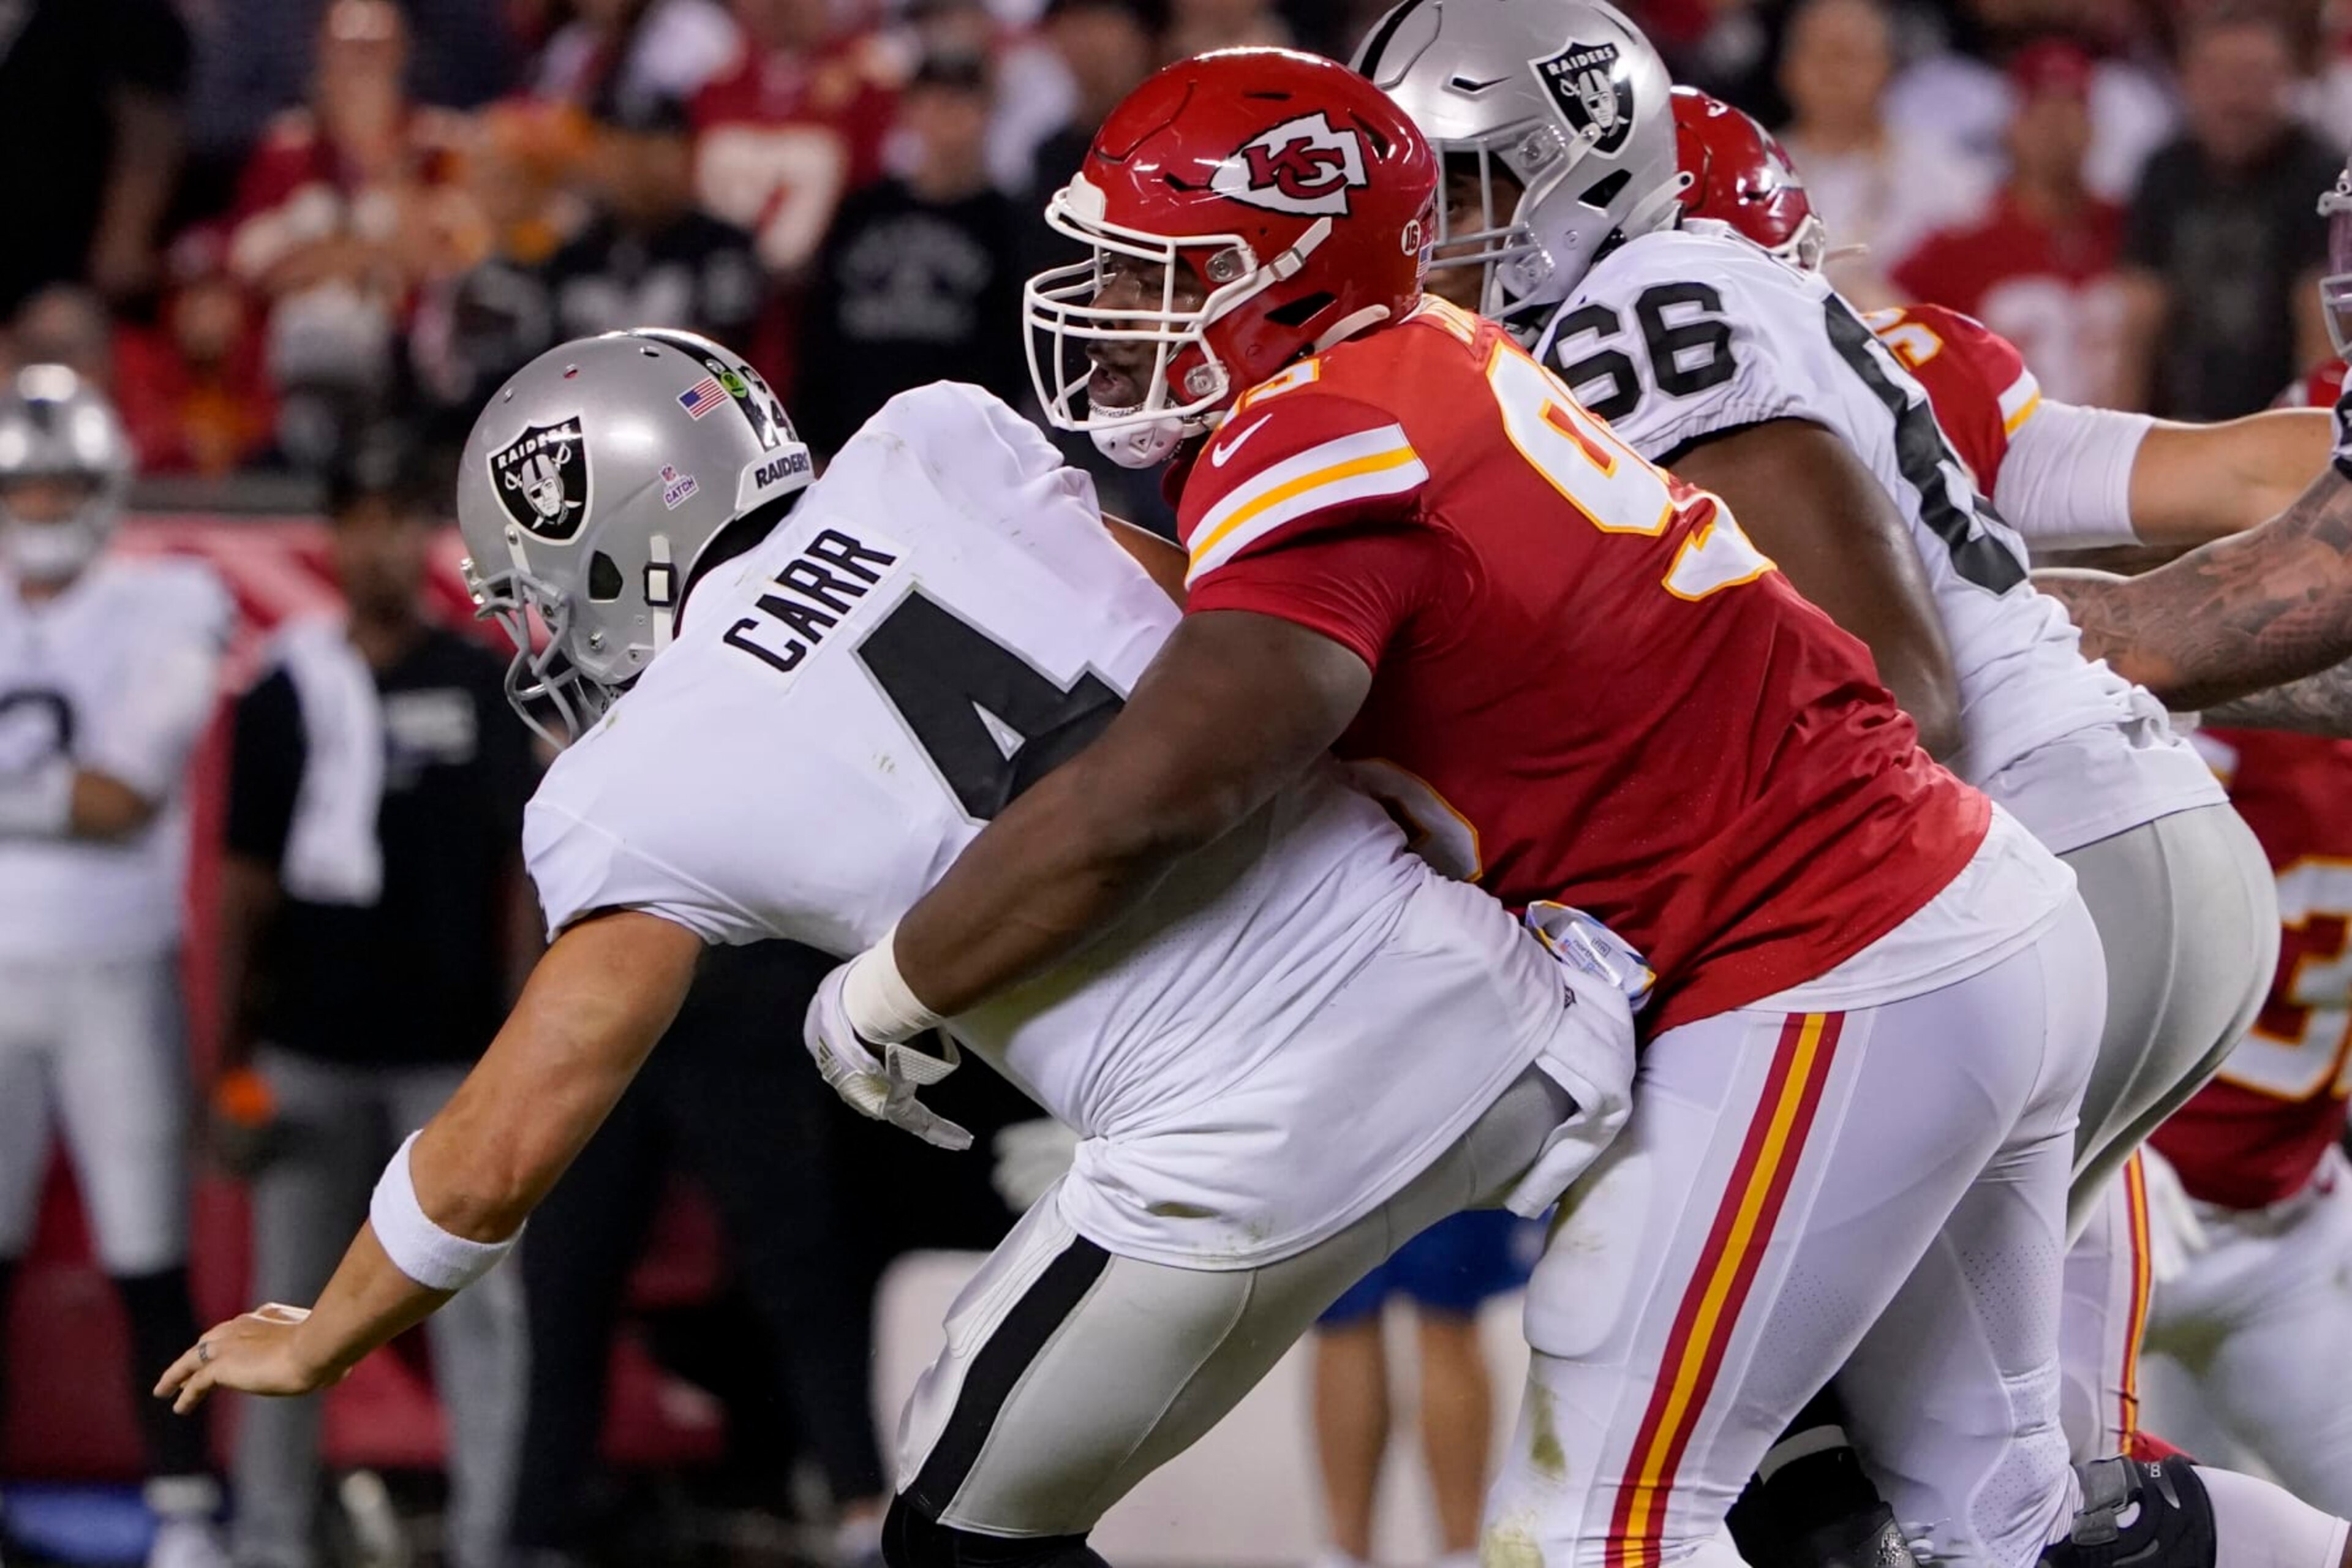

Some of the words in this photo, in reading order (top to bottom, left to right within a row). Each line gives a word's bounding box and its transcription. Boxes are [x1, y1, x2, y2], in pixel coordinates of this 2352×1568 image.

[1547, 46, 1614, 76] RAIDERS
[1242, 135, 1348, 200] KC
[1542, 282, 1737, 424] 66
[497, 423, 572, 470] RAIDERS
[755, 452, 809, 489] RAIDERS
[665, 477, 695, 503] CATCH
[723, 529, 897, 673] CARR
[849, 581, 1129, 826] 4
